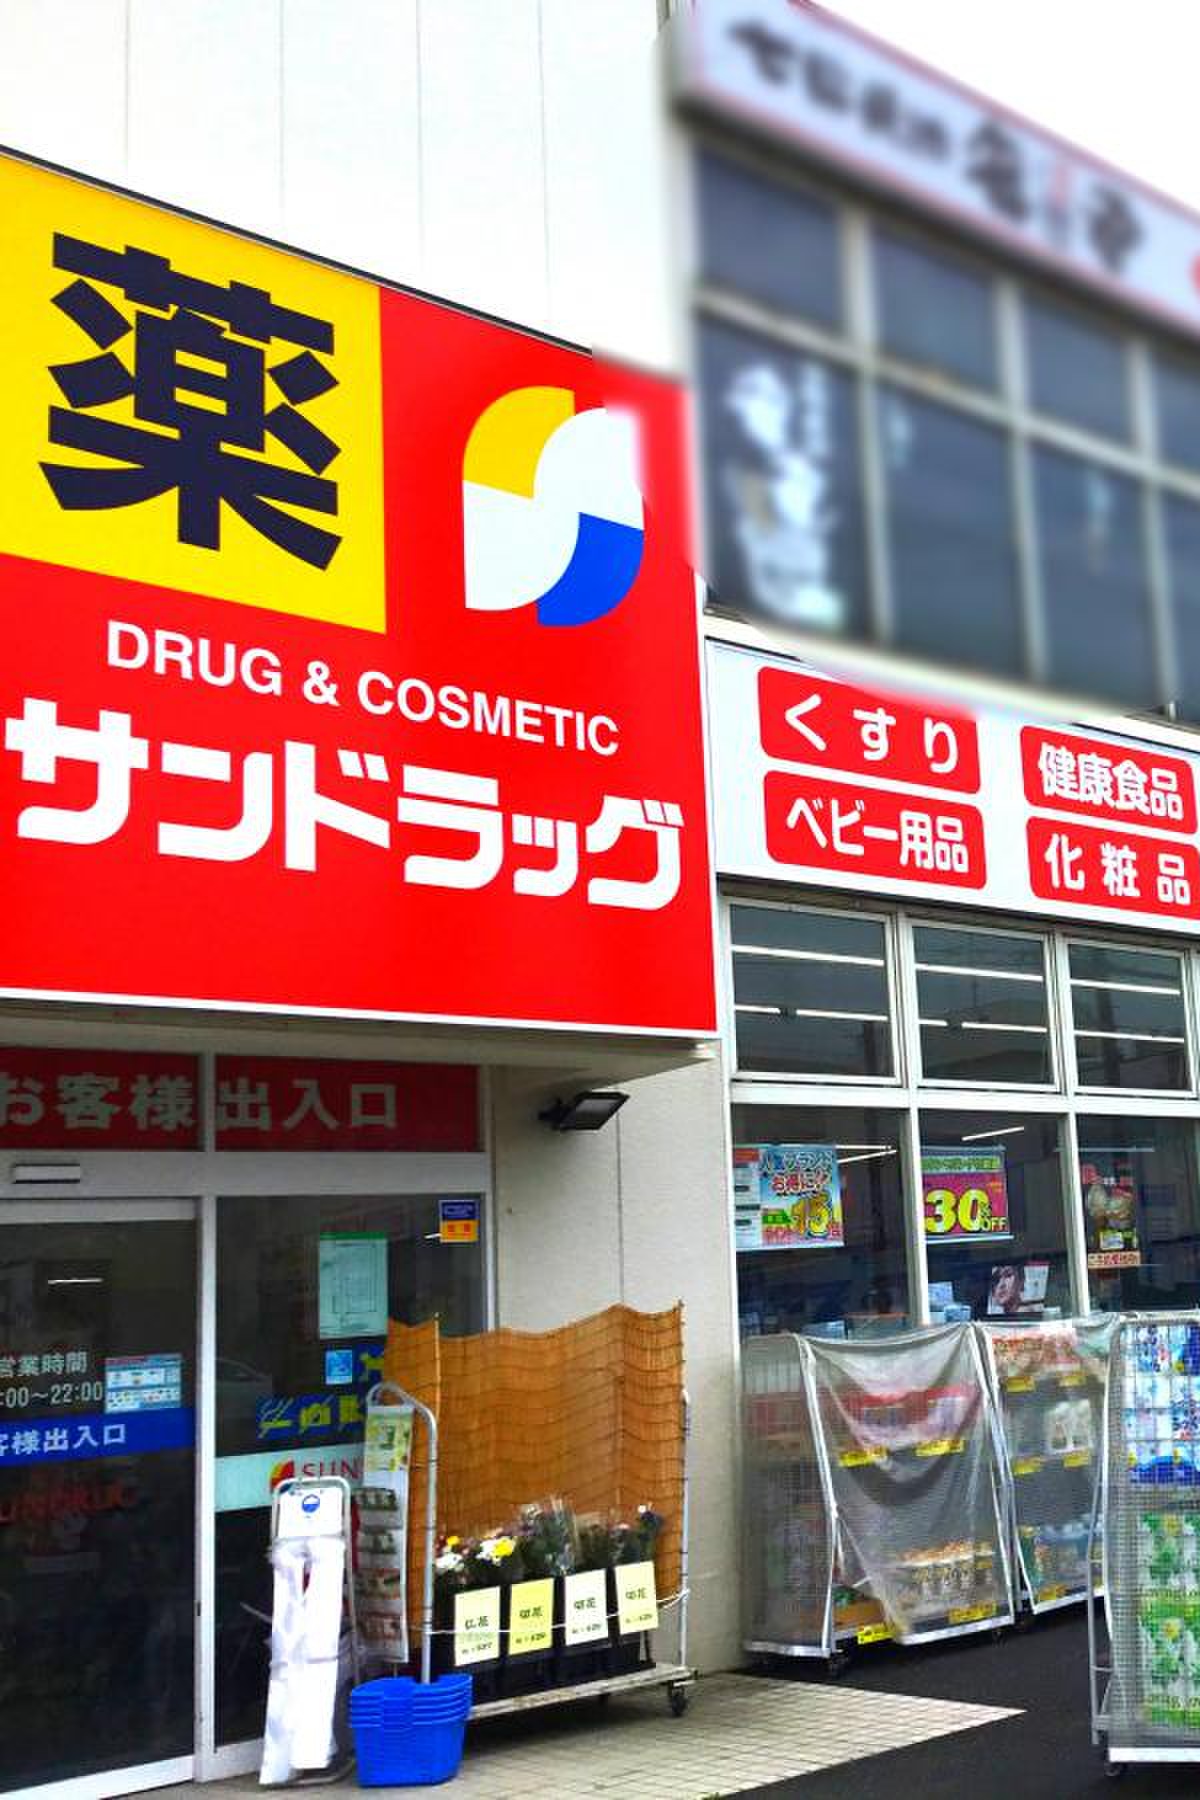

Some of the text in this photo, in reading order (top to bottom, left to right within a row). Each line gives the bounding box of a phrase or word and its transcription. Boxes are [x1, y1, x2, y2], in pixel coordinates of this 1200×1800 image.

[38, 231, 343, 571] 薬
[106, 619, 620, 756] DRUG & COSMETIC
[784, 694, 959, 773] くすり
[5, 698, 685, 911] サンドラッグ
[1037, 742, 1185, 820] 健康食品
[786, 797, 970, 874] ベビー用品
[1045, 834, 1192, 906] 化粧品
[0, 1073, 398, 1131] お客様出入口
